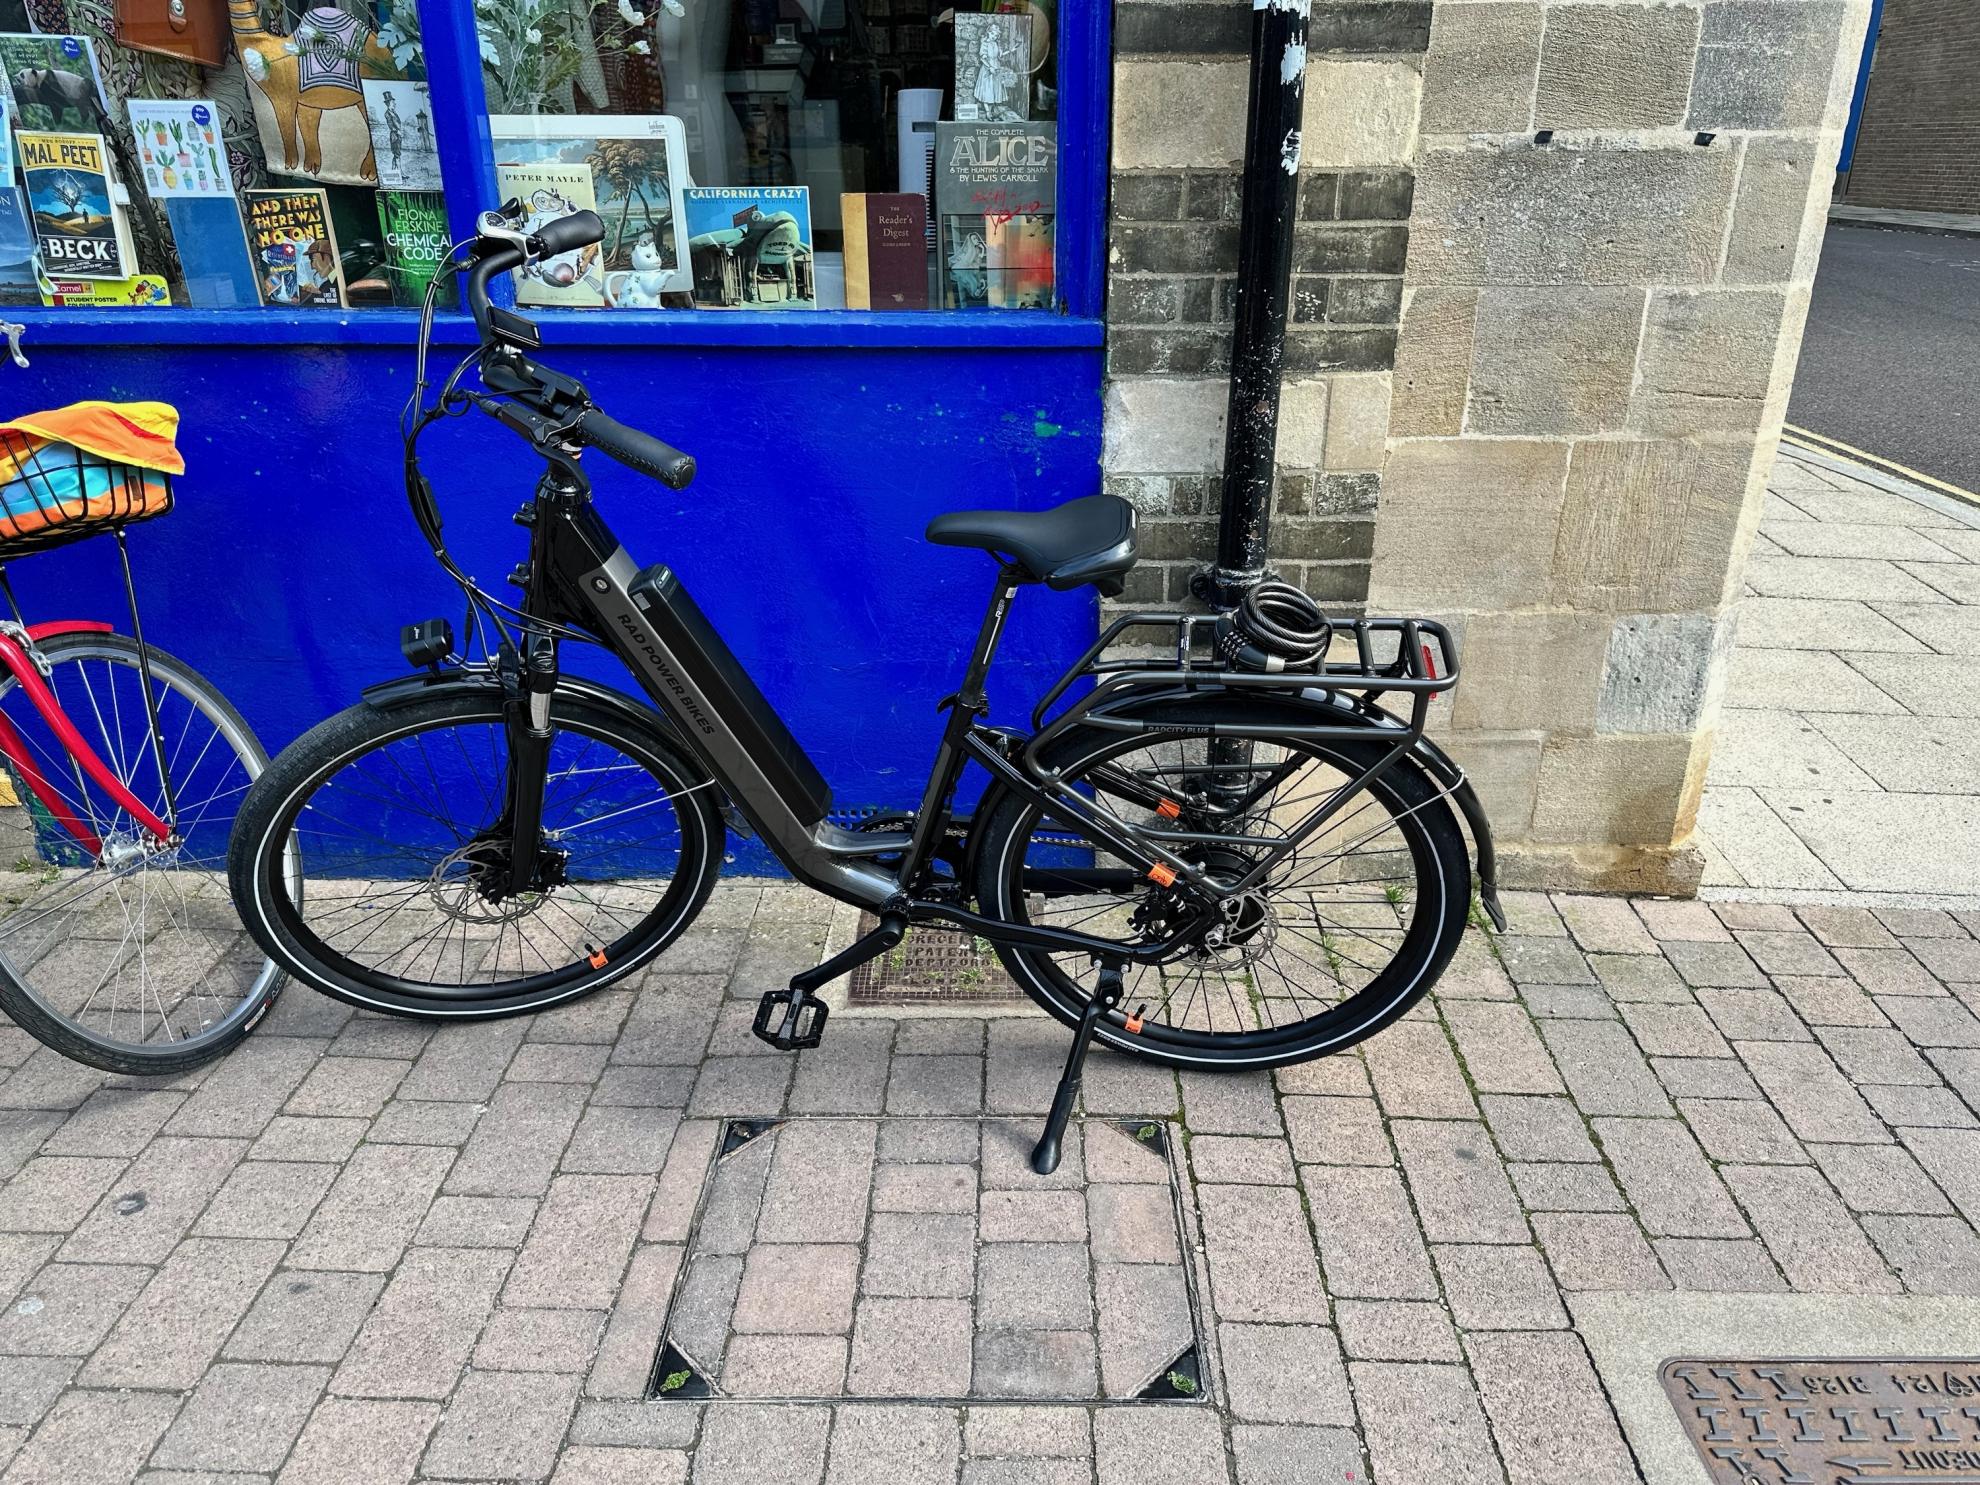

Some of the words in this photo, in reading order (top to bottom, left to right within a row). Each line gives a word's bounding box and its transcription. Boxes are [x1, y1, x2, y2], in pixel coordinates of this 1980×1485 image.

[23, 143, 57, 166] MAL
[60, 144, 97, 168] PEET
[950, 136, 1049, 166] ALICE
[505, 174, 542, 182] PETER
[547, 175, 584, 183] MAYLE
[1000, 174, 1039, 182] CARROLL
[689, 189, 761, 199] CALIFORNIA
[764, 189, 803, 199] CRAZY
[252, 199, 281, 216] AND
[283, 194, 318, 211] THEN
[254, 213, 295, 230] THERE
[296, 209, 322, 223] WAS
[397, 209, 438, 221] FIONA
[878, 215, 913, 224] Reader's
[395, 220, 444, 233] ERSKINE
[257, 229, 285, 248] NO
[289, 223, 325, 242] ONE
[883, 228, 909, 239] Digest
[47, 238, 112, 261] BECK
[403, 247, 444, 261] CODE
[617, 614, 646, 645] RAD
[642, 645, 685, 697] POWER
[679, 694, 716, 736] BIKES
[905, 957, 992, 967] DEPTFORD
